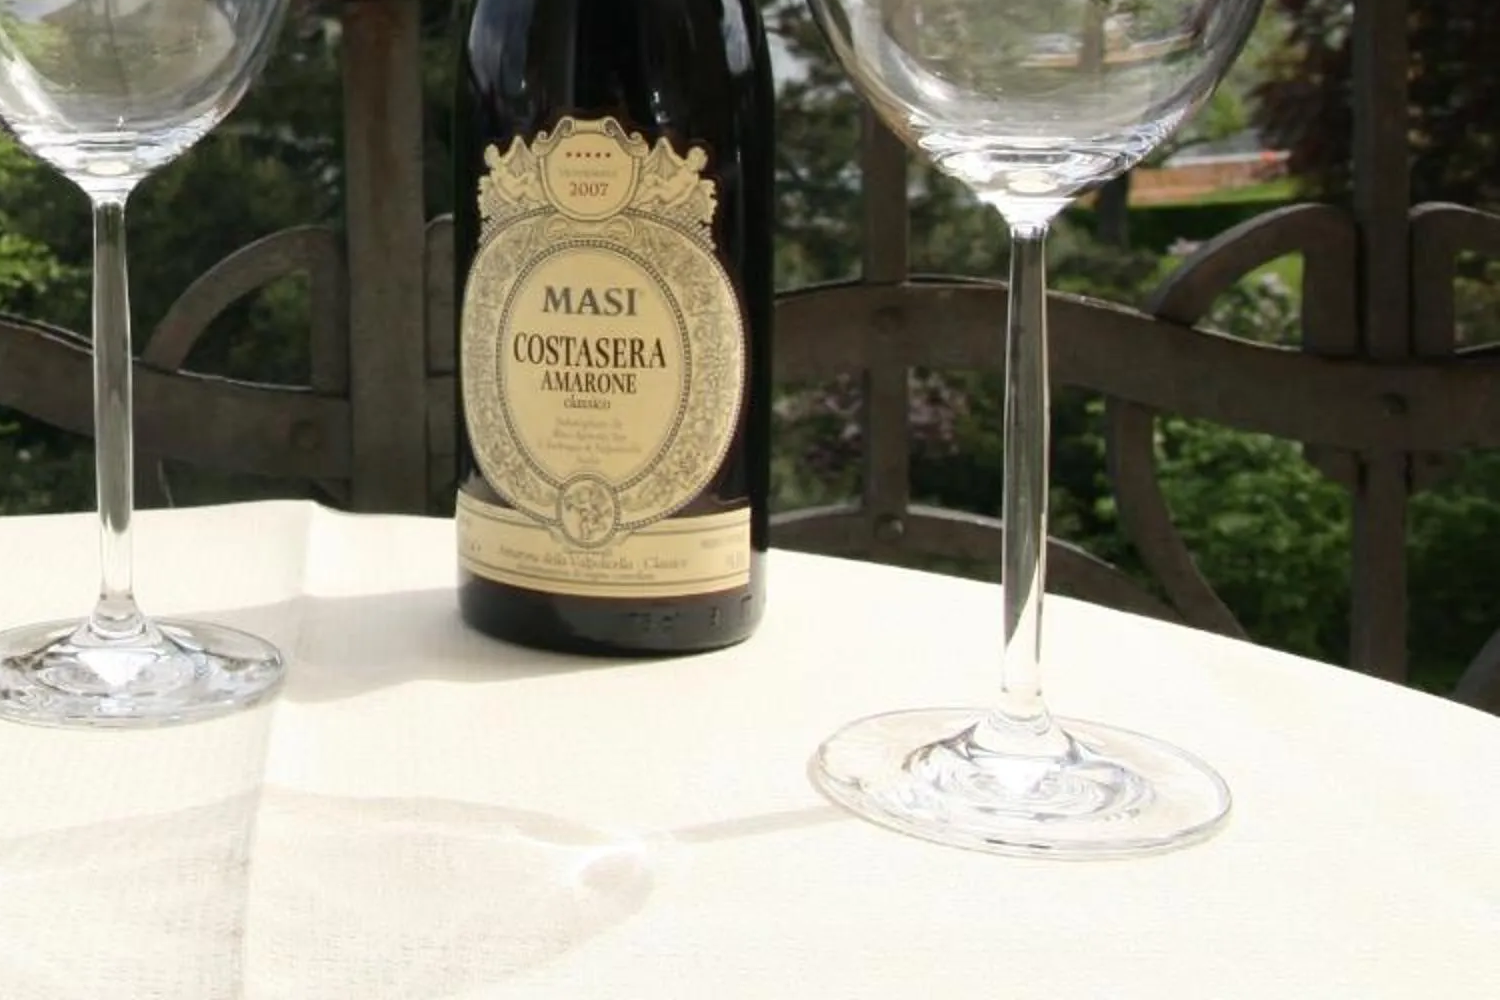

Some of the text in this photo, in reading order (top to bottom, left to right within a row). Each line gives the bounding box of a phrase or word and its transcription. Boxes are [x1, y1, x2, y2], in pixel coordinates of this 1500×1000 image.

[569, 181, 609, 197] 2007
[542, 284, 638, 317] MASI
[512, 331, 667, 369] COSTASERA
[540, 369, 638, 395] AMARONE
